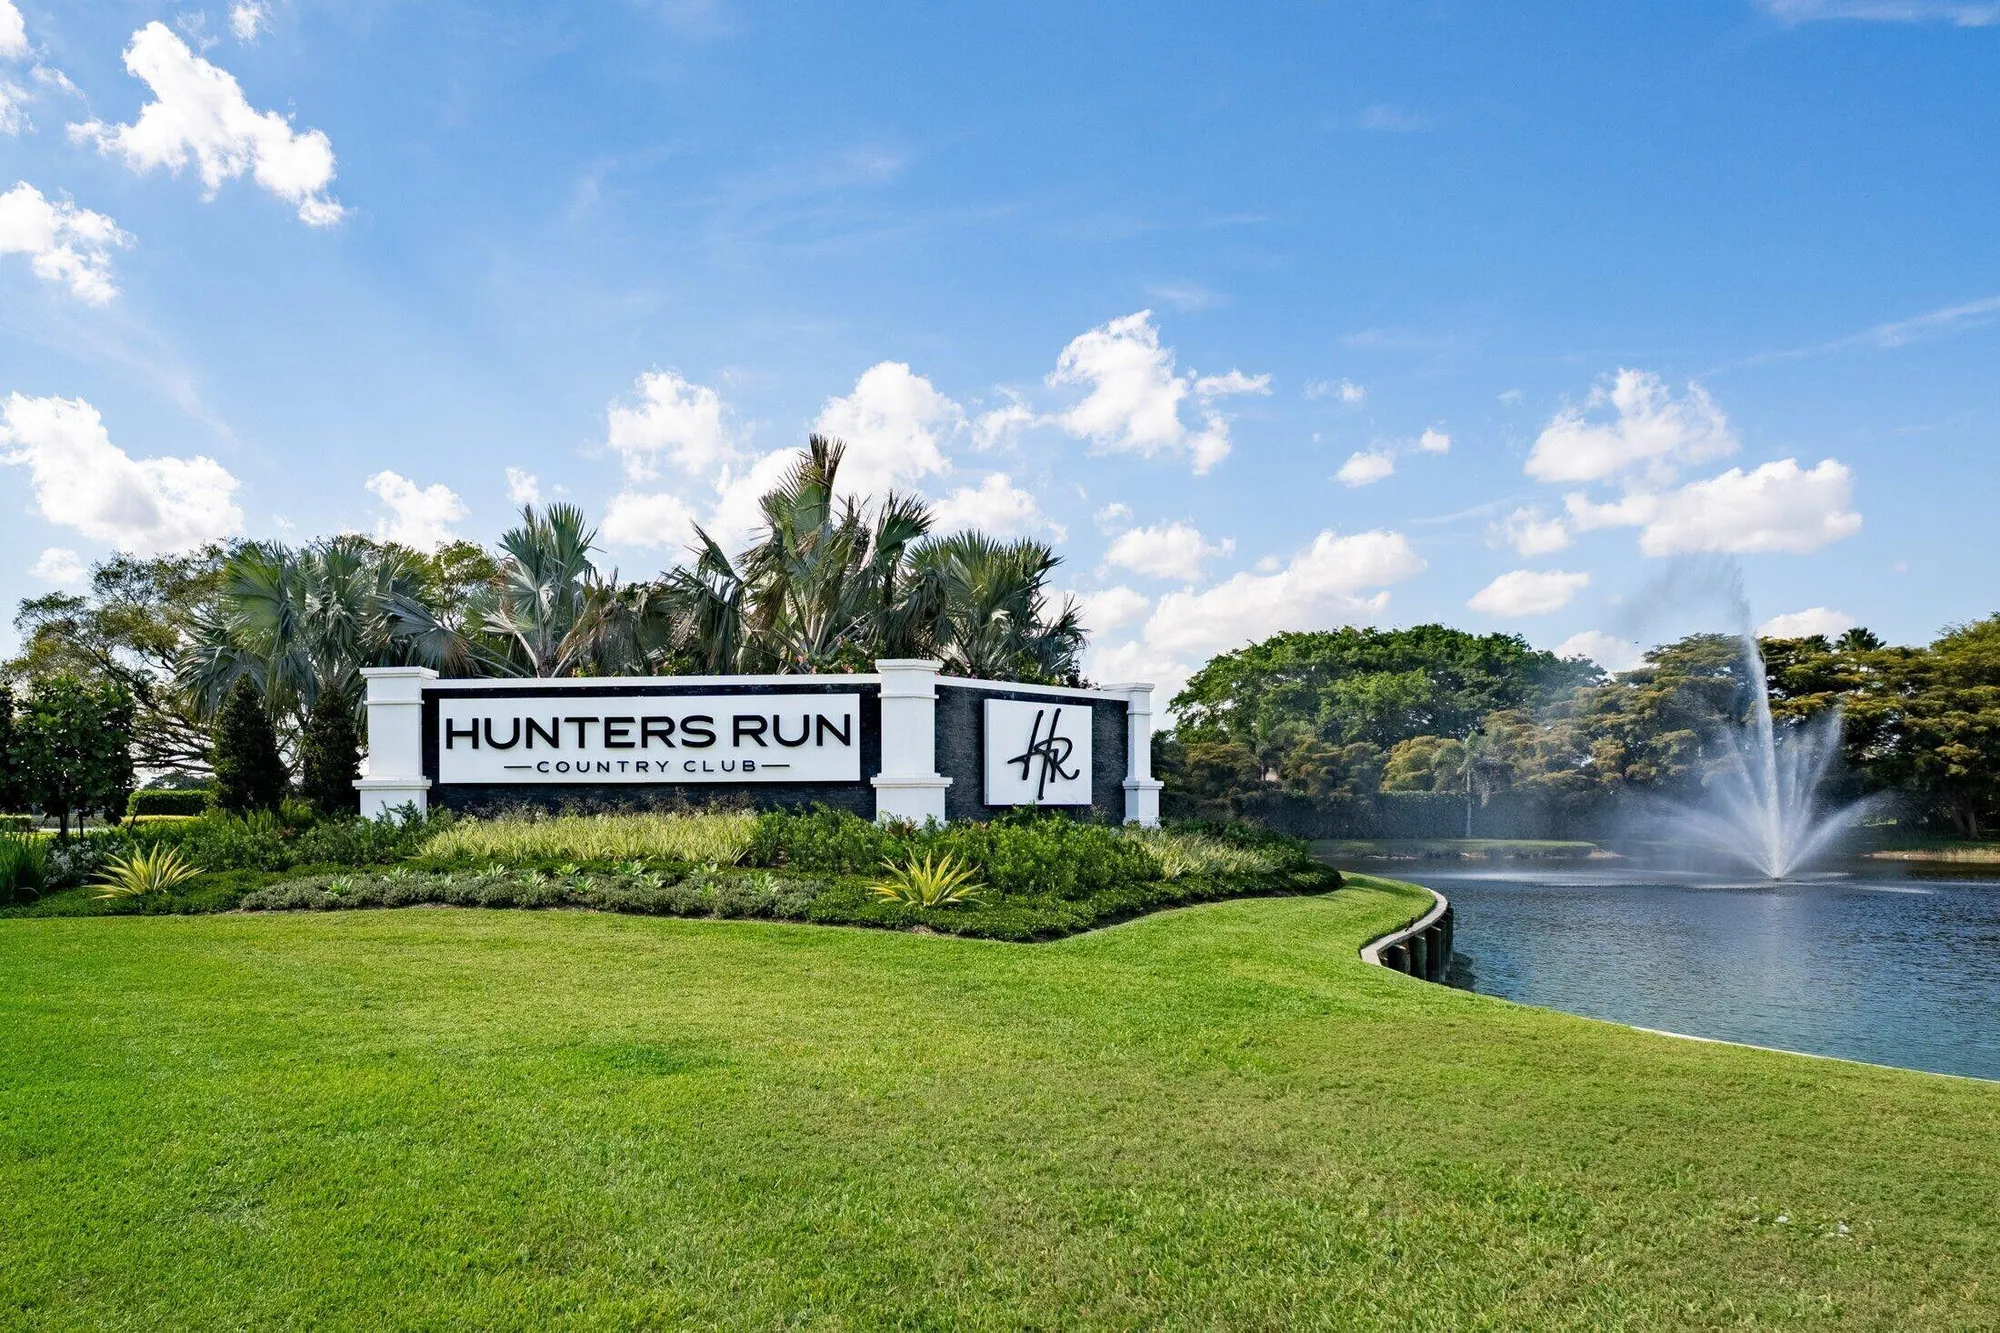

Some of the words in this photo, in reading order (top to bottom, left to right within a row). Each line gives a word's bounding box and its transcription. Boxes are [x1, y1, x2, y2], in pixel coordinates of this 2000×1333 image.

[446, 715, 717, 751] HUNTERS
[733, 714, 851, 748] RUN
[536, 760, 670, 774] COUNTRY
[683, 759, 756, 773] CLUB
[1006, 708, 1081, 800] HR
